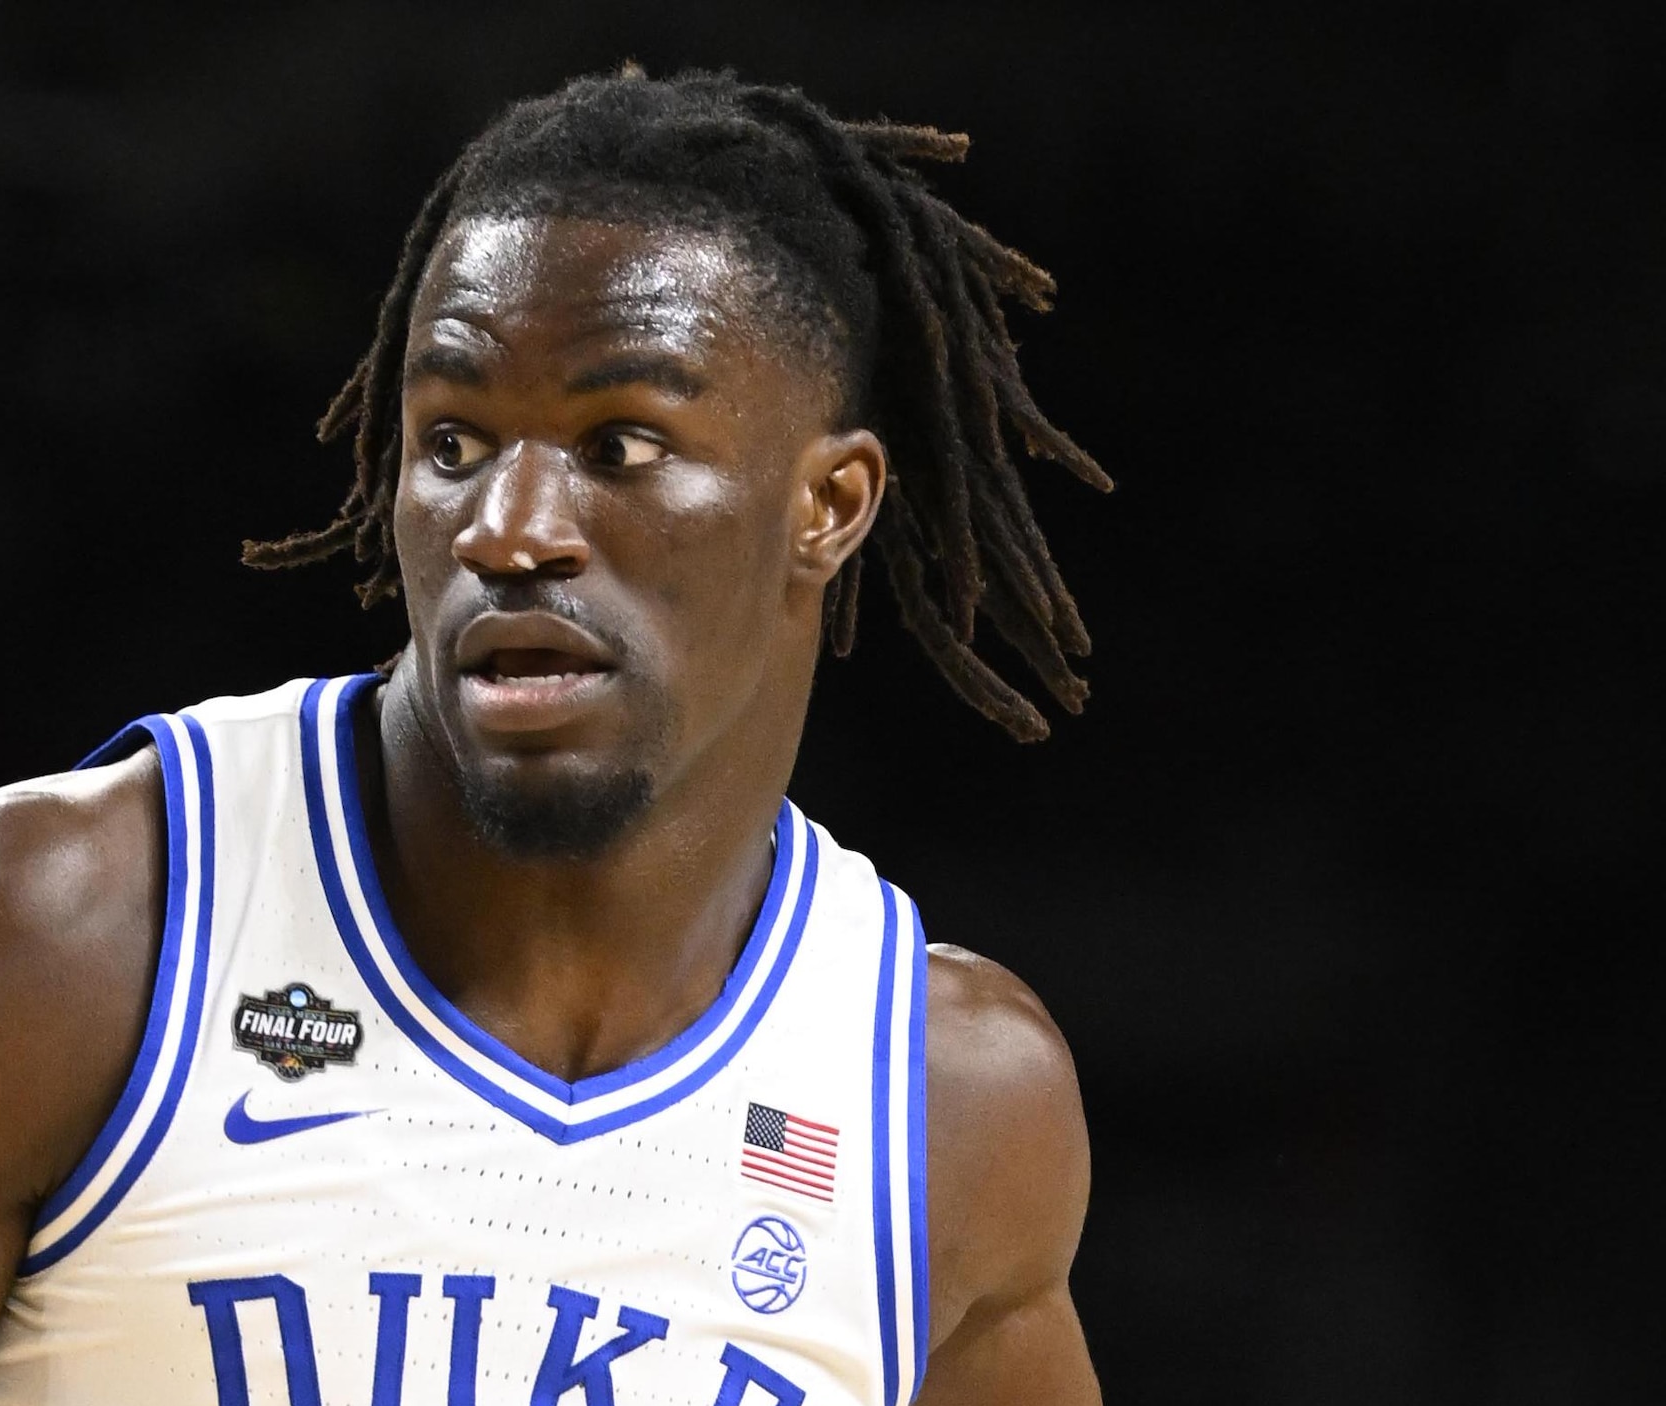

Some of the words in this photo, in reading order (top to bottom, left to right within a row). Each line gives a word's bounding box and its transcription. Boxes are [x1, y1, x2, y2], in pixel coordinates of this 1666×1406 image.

[239, 1010, 296, 1039] FINAL
[298, 1019, 357, 1046] FOUR
[741, 1247, 807, 1279] ACC
